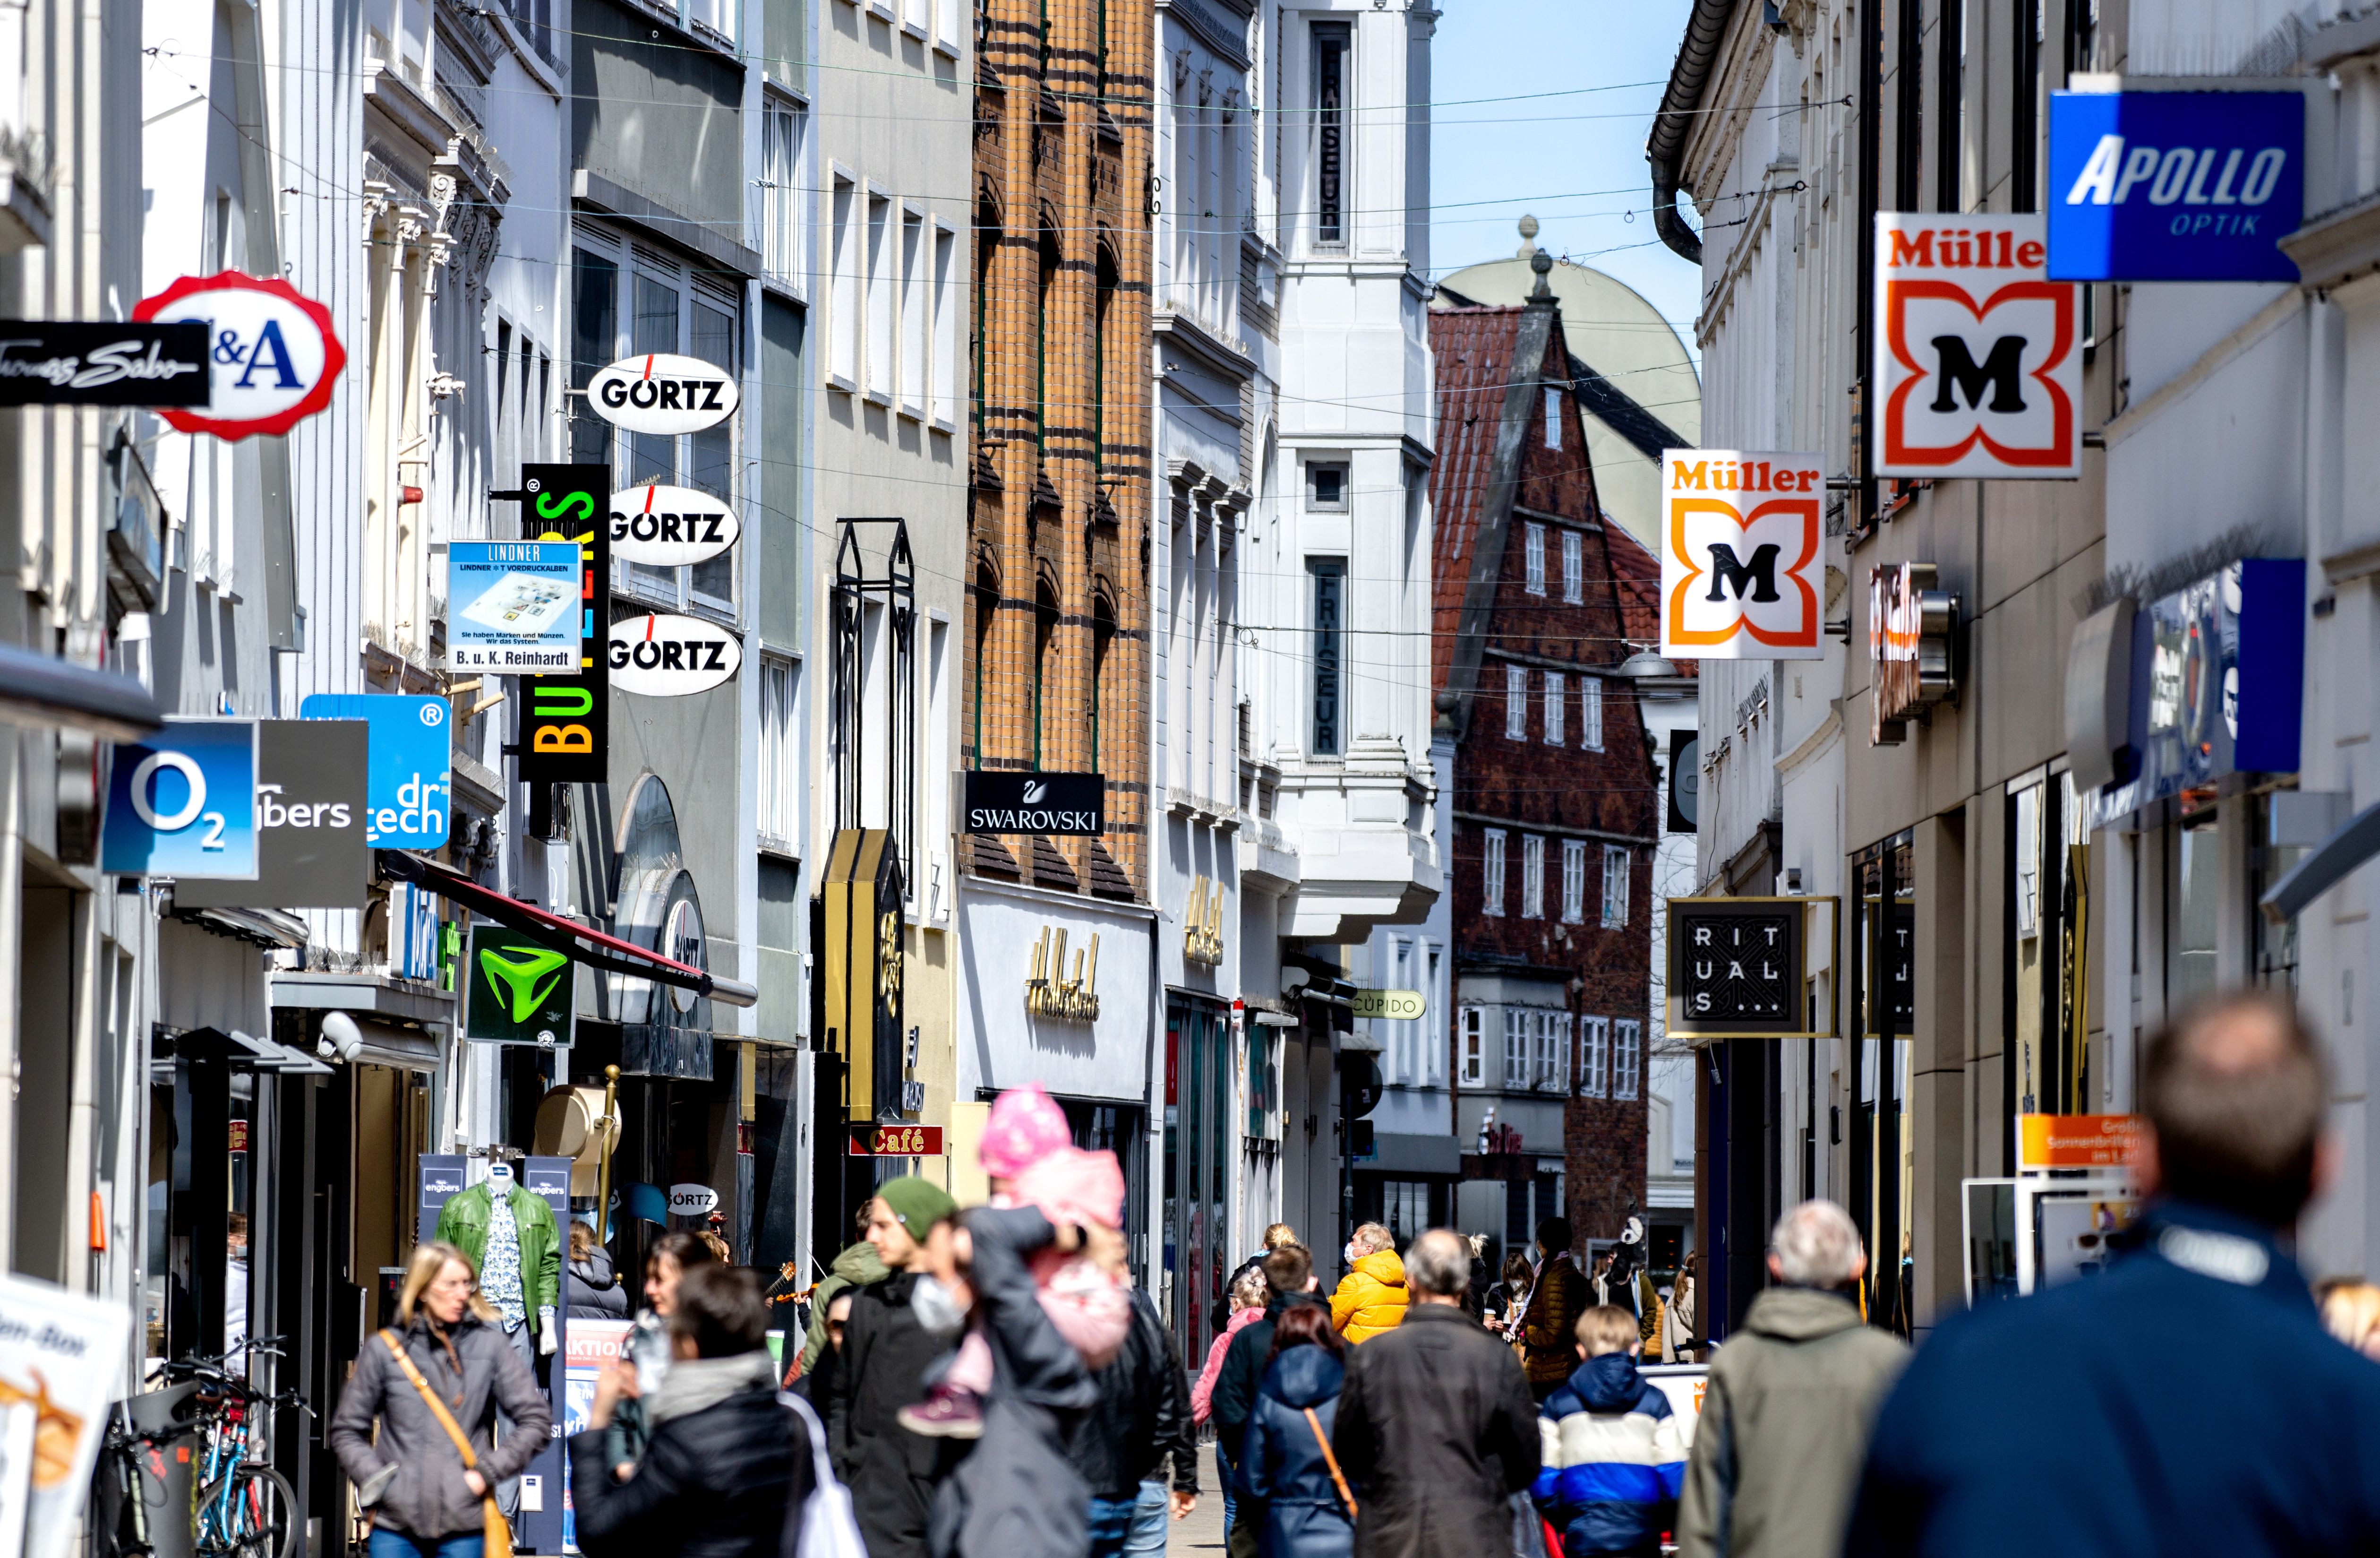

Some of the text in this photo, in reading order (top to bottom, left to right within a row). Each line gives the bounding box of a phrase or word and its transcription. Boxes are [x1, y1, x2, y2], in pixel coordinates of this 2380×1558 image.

[2066, 134, 2286, 206] APOLLO
[2170, 214, 2261, 236] OPTIK
[1888, 229, 2046, 268] Mülle
[178, 319, 305, 389] &A
[1671, 460, 1819, 492] Müller
[488, 544, 540, 562] LINDNER
[456, 651, 568, 666] B. u. K. Reinhardt
[1315, 573, 1336, 749] FRISEUR
[397, 772, 439, 809] dr
[257, 795, 351, 831] bers
[971, 809, 1096, 830] SWAROVSKI
[1353, 998, 1416, 1013] CUPIDO
[870, 1128, 924, 1152] Café
[426, 1184, 460, 1193] engbers
[530, 1186, 565, 1196] engbers
